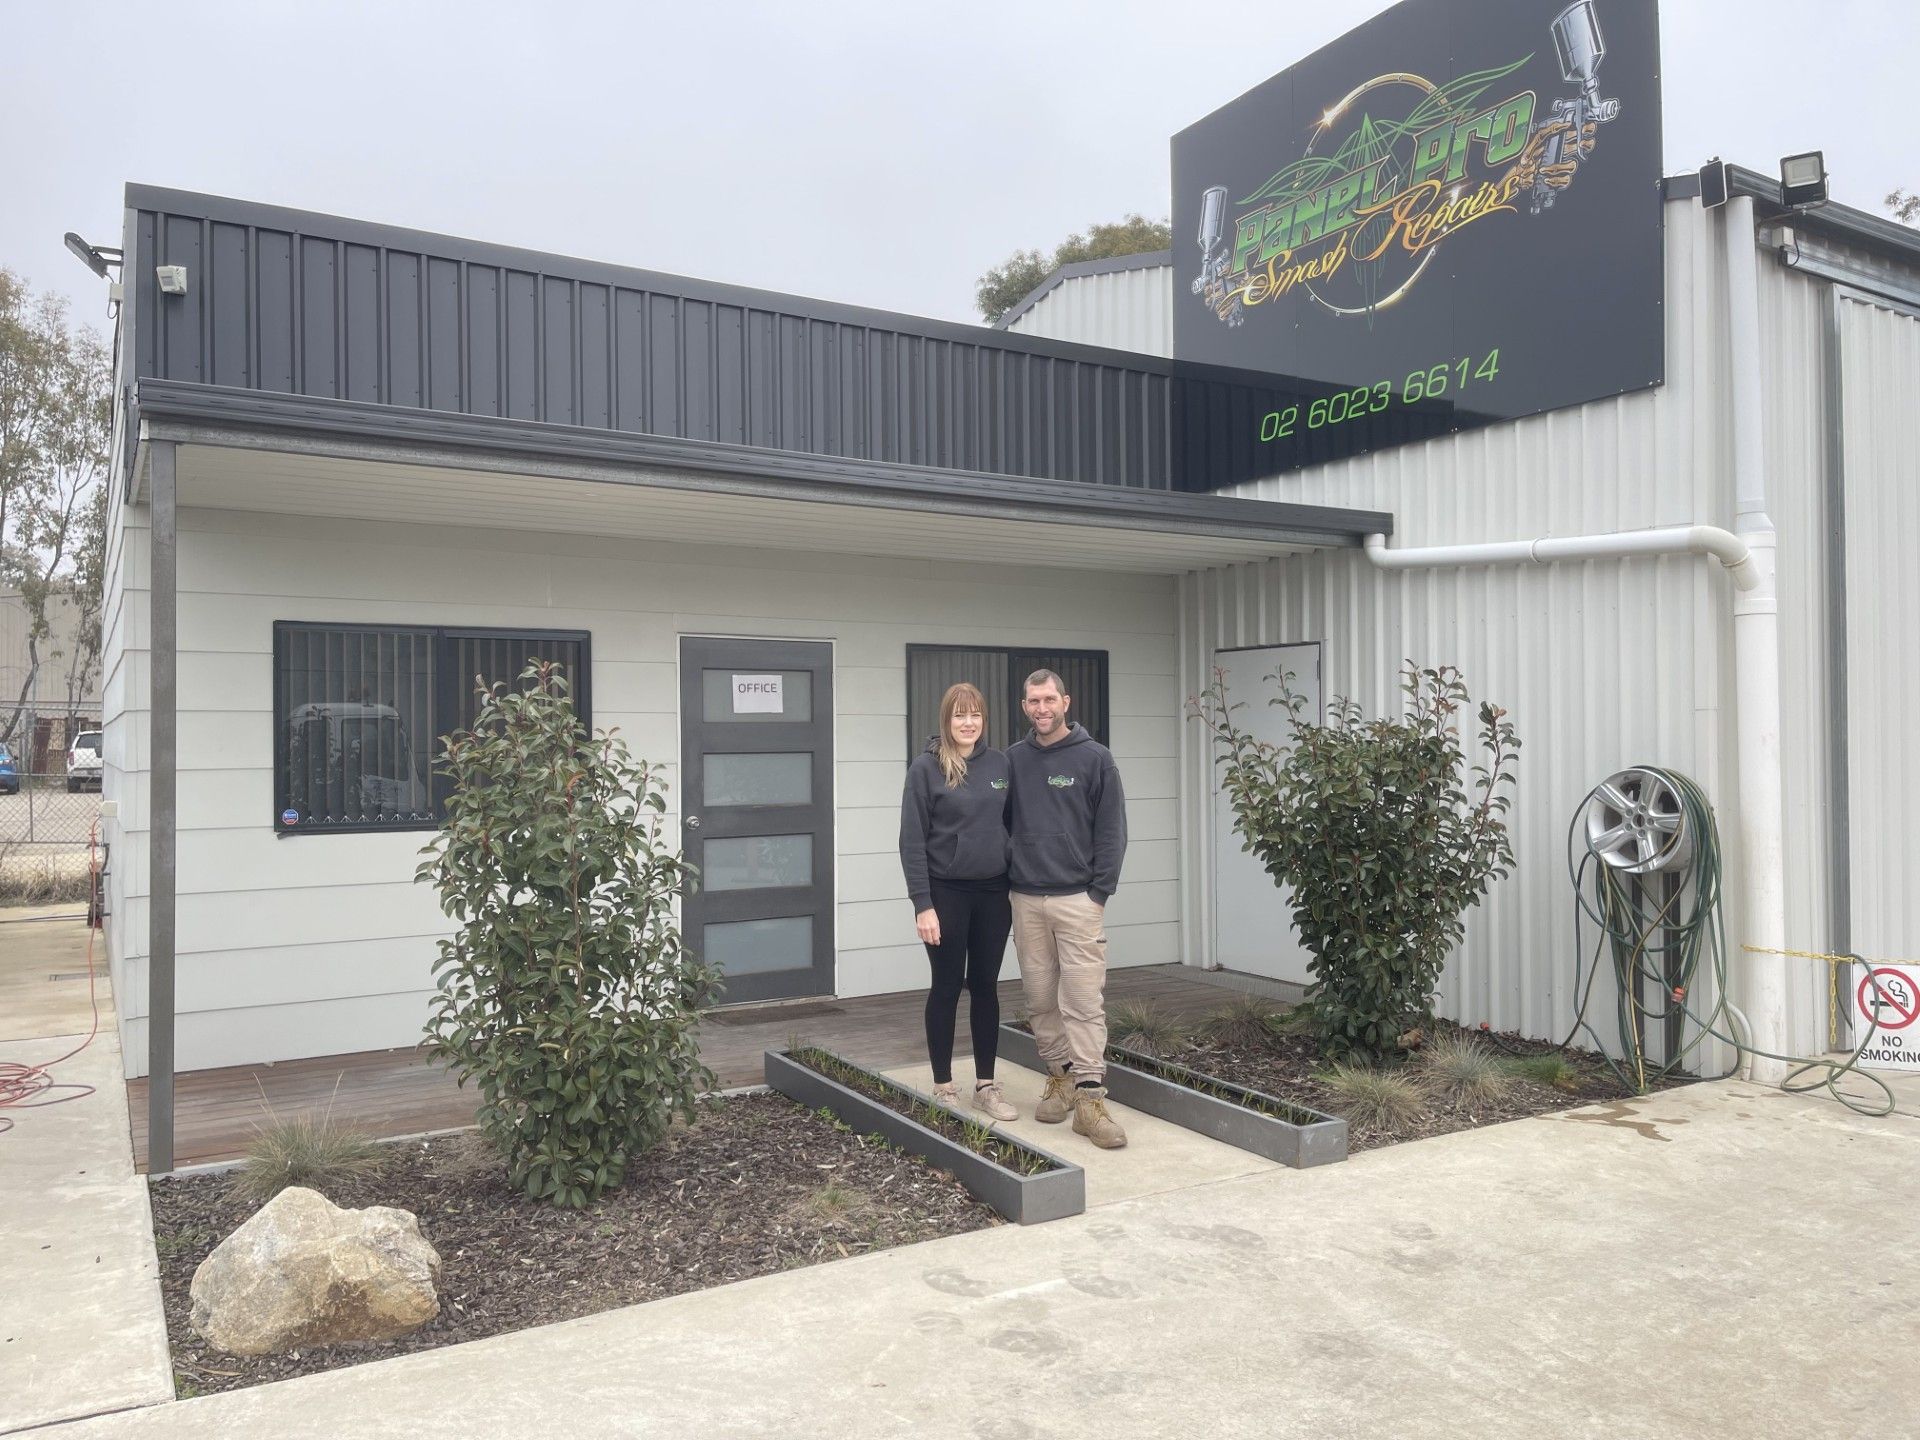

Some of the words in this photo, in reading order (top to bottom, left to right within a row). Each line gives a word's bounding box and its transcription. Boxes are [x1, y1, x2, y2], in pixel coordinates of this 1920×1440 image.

[1222, 231, 1347, 306] Smash
[1351, 175, 1520, 262] Repairs
[1260, 406, 1298, 442] 02
[1307, 380, 1392, 429] 6023
[1403, 348, 1499, 404] 6614
[738, 682, 778, 694] OFFICE
[1881, 1035, 1903, 1048] NO
